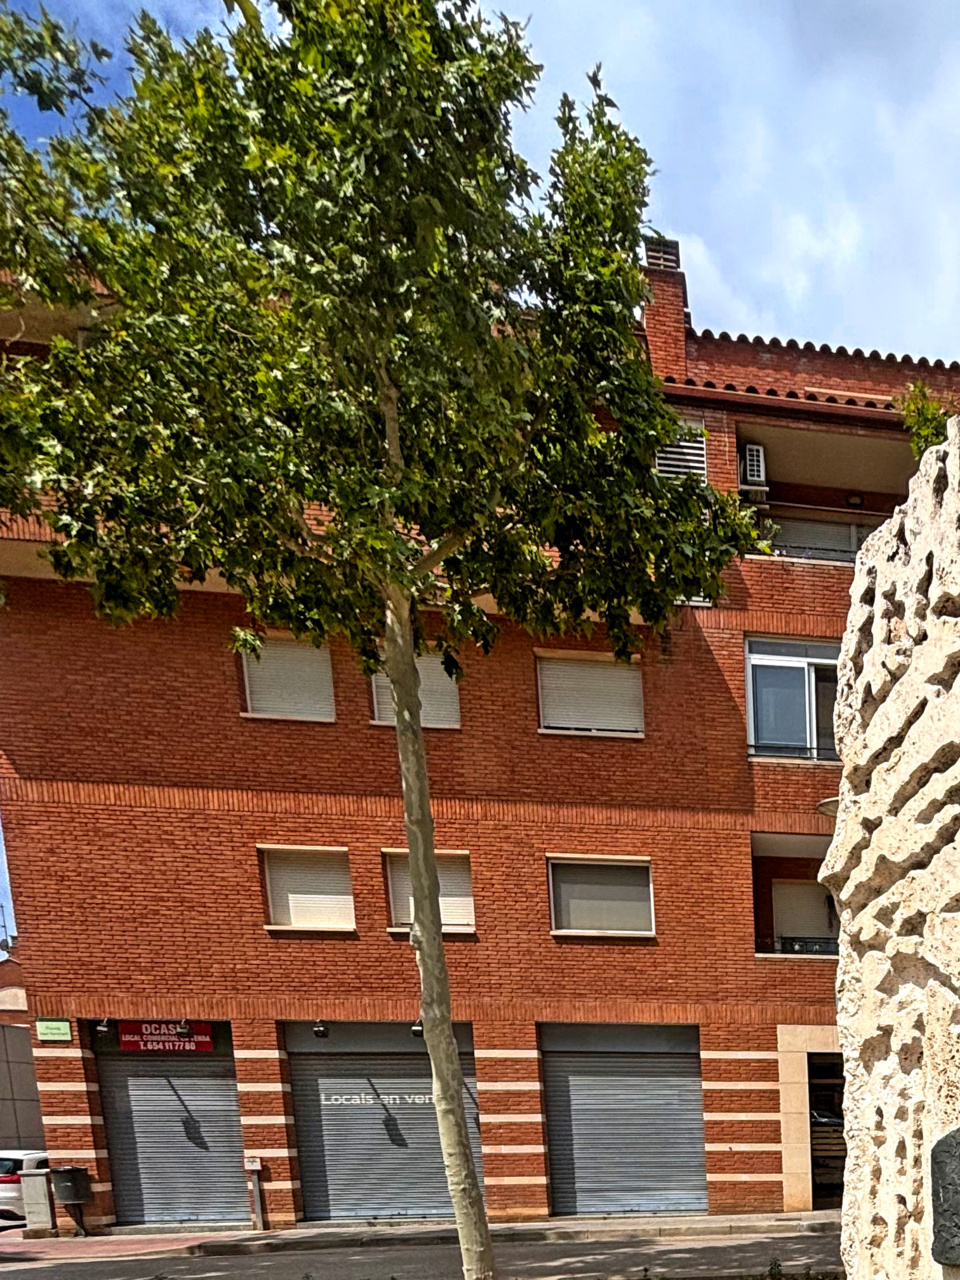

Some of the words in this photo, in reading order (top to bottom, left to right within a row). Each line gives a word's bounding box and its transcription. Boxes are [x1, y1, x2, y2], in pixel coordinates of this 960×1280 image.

[319, 1093, 375, 1105] Locals
[379, 1095, 401, 1104] en
[404, 1095, 435, 1104] ven
